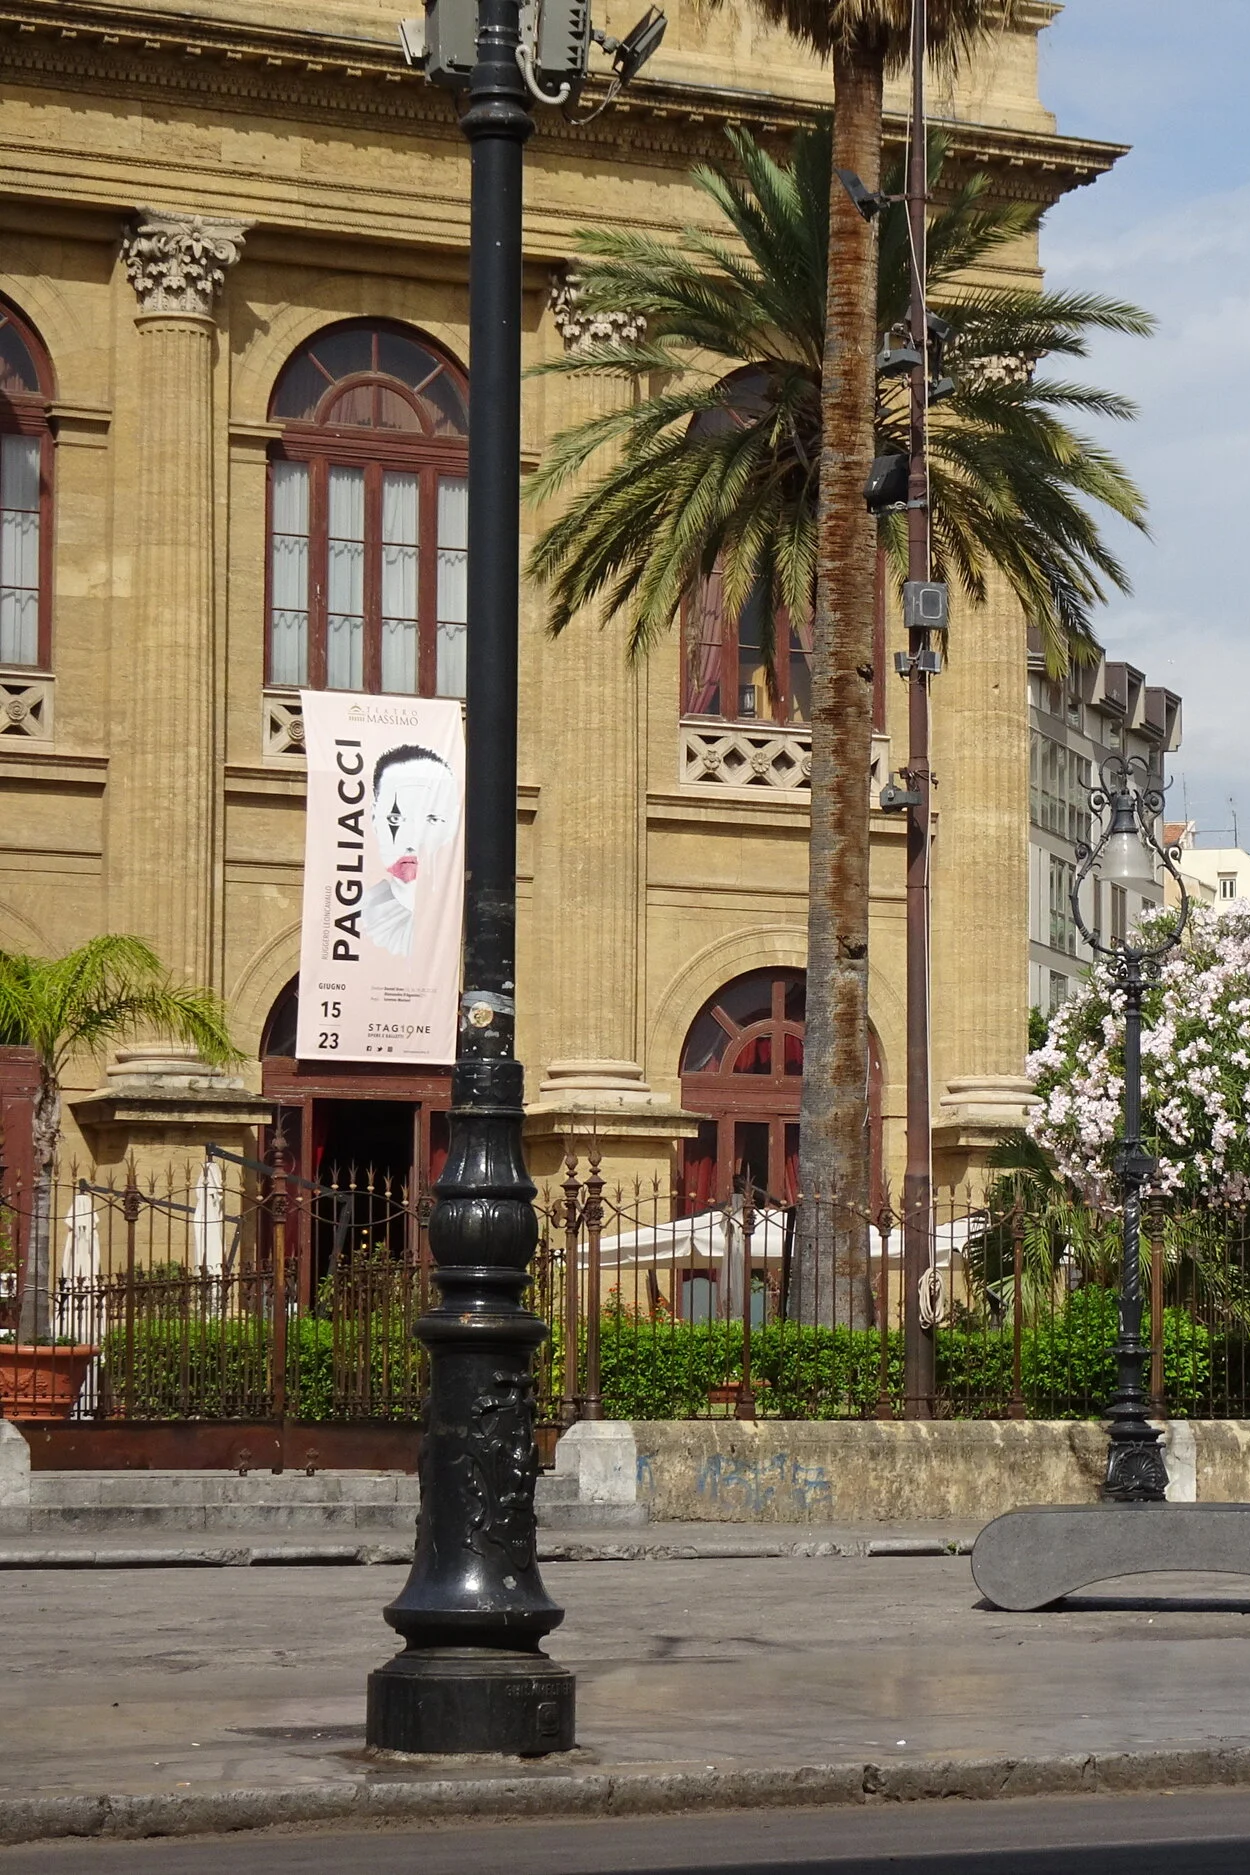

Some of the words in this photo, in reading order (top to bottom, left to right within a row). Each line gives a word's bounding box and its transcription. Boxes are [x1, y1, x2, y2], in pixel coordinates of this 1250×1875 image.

[367, 707, 418, 715] TEATRO
[367, 714, 419, 727] MASSIMO
[333, 739, 365, 961] PAGLIACCI
[323, 886, 332, 928] LEONCAVALLO
[322, 930, 330, 960] RUGGERO
[319, 982, 346, 991] GIUGNO
[321, 1001, 341, 1018] 15
[319, 1032, 339, 1049] 23
